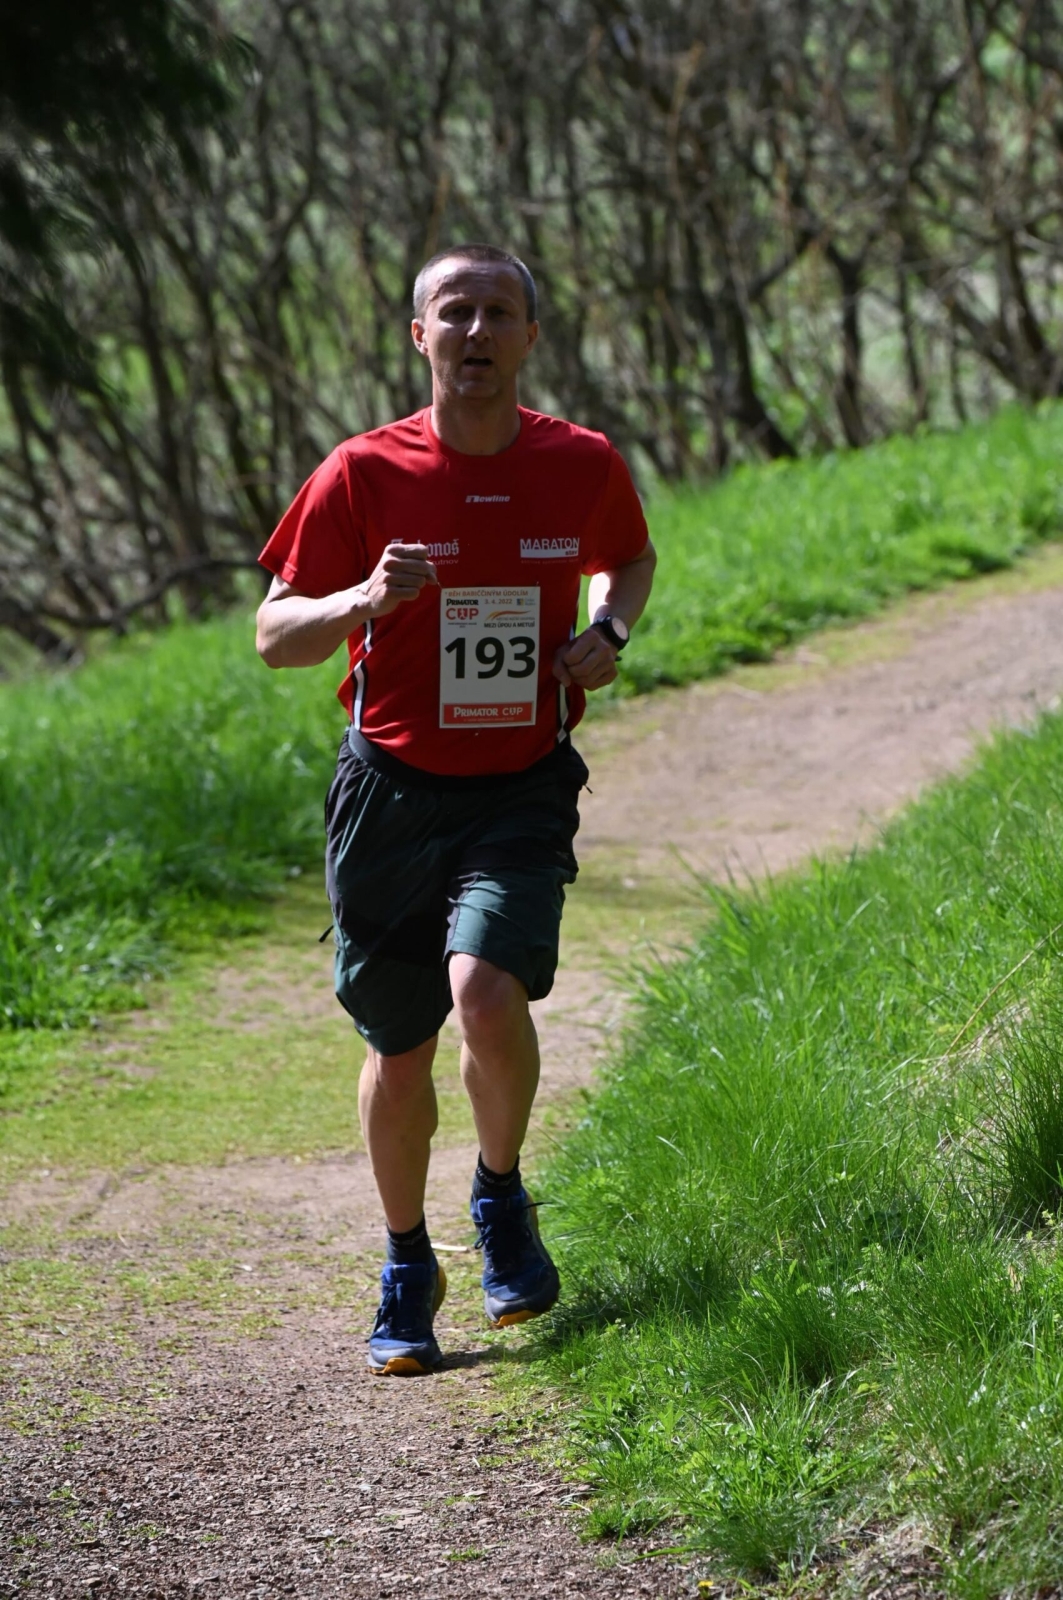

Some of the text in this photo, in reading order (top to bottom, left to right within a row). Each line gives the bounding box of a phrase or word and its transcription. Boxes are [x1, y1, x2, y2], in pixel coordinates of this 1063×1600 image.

[520, 537, 580, 550] MARATON
[446, 598, 479, 606] PRIMATOR
[446, 607, 479, 620] CUP
[444, 636, 536, 679] 193
[453, 707, 524, 718] PRIMATOR CUP
